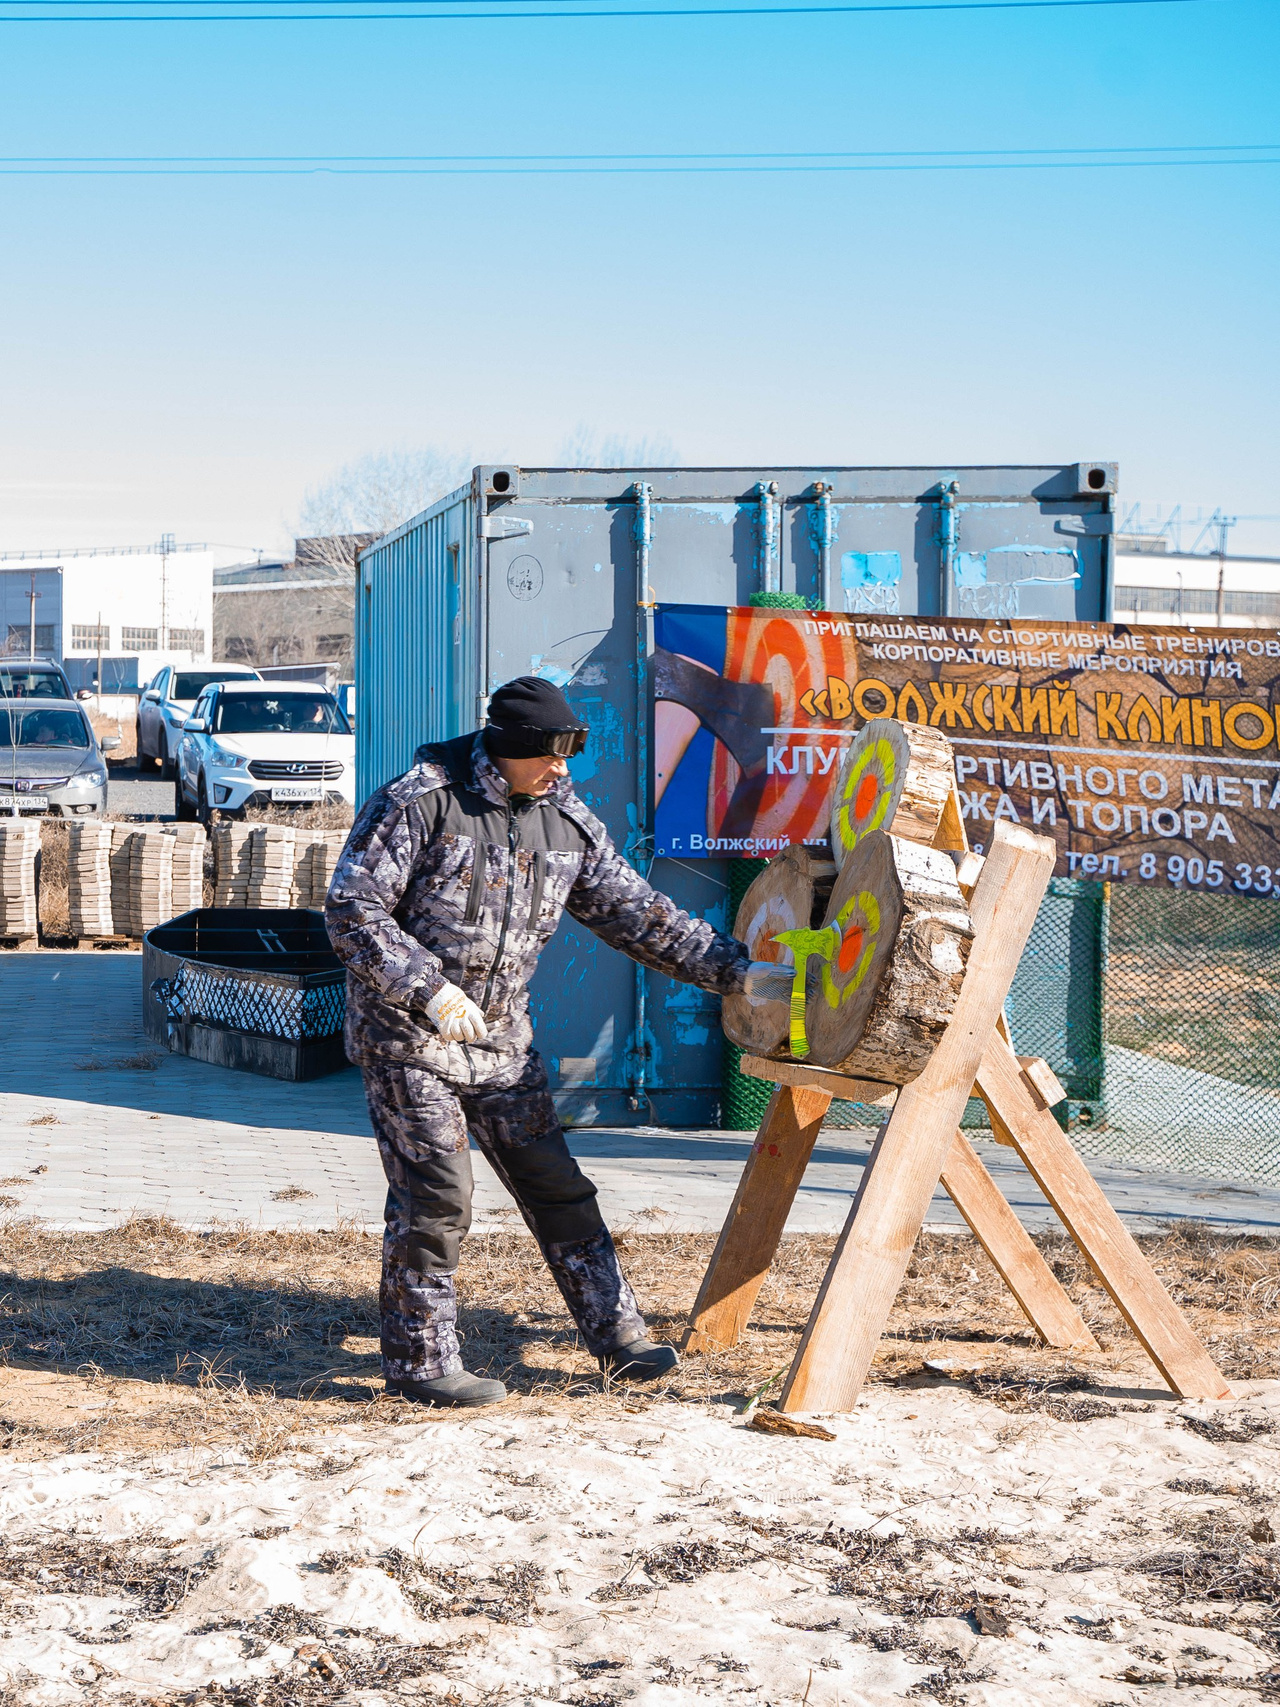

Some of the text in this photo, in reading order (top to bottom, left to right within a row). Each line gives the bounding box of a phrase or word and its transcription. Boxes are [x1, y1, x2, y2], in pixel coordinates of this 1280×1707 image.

[804, 621, 947, 641] ПРИГЛАШАЕМ
[952, 627, 984, 643] НА
[987, 629, 1146, 651] СПОРТИВНЫЕ
[872, 643, 1242, 679] КОРПОРАТИВНЫЕ МЕРОПРИЯТИЯ
[1094, 690, 1280, 751] КЛИНО
[954, 755, 1169, 800] РТИВНОГО
[958, 790, 1237, 844] ЖА И ТОПОРА
[672, 837, 683, 850] г.
[1065, 851, 1128, 876] тел.
[1139, 852, 1157, 879] 8
[1167, 855, 1224, 887] 905
